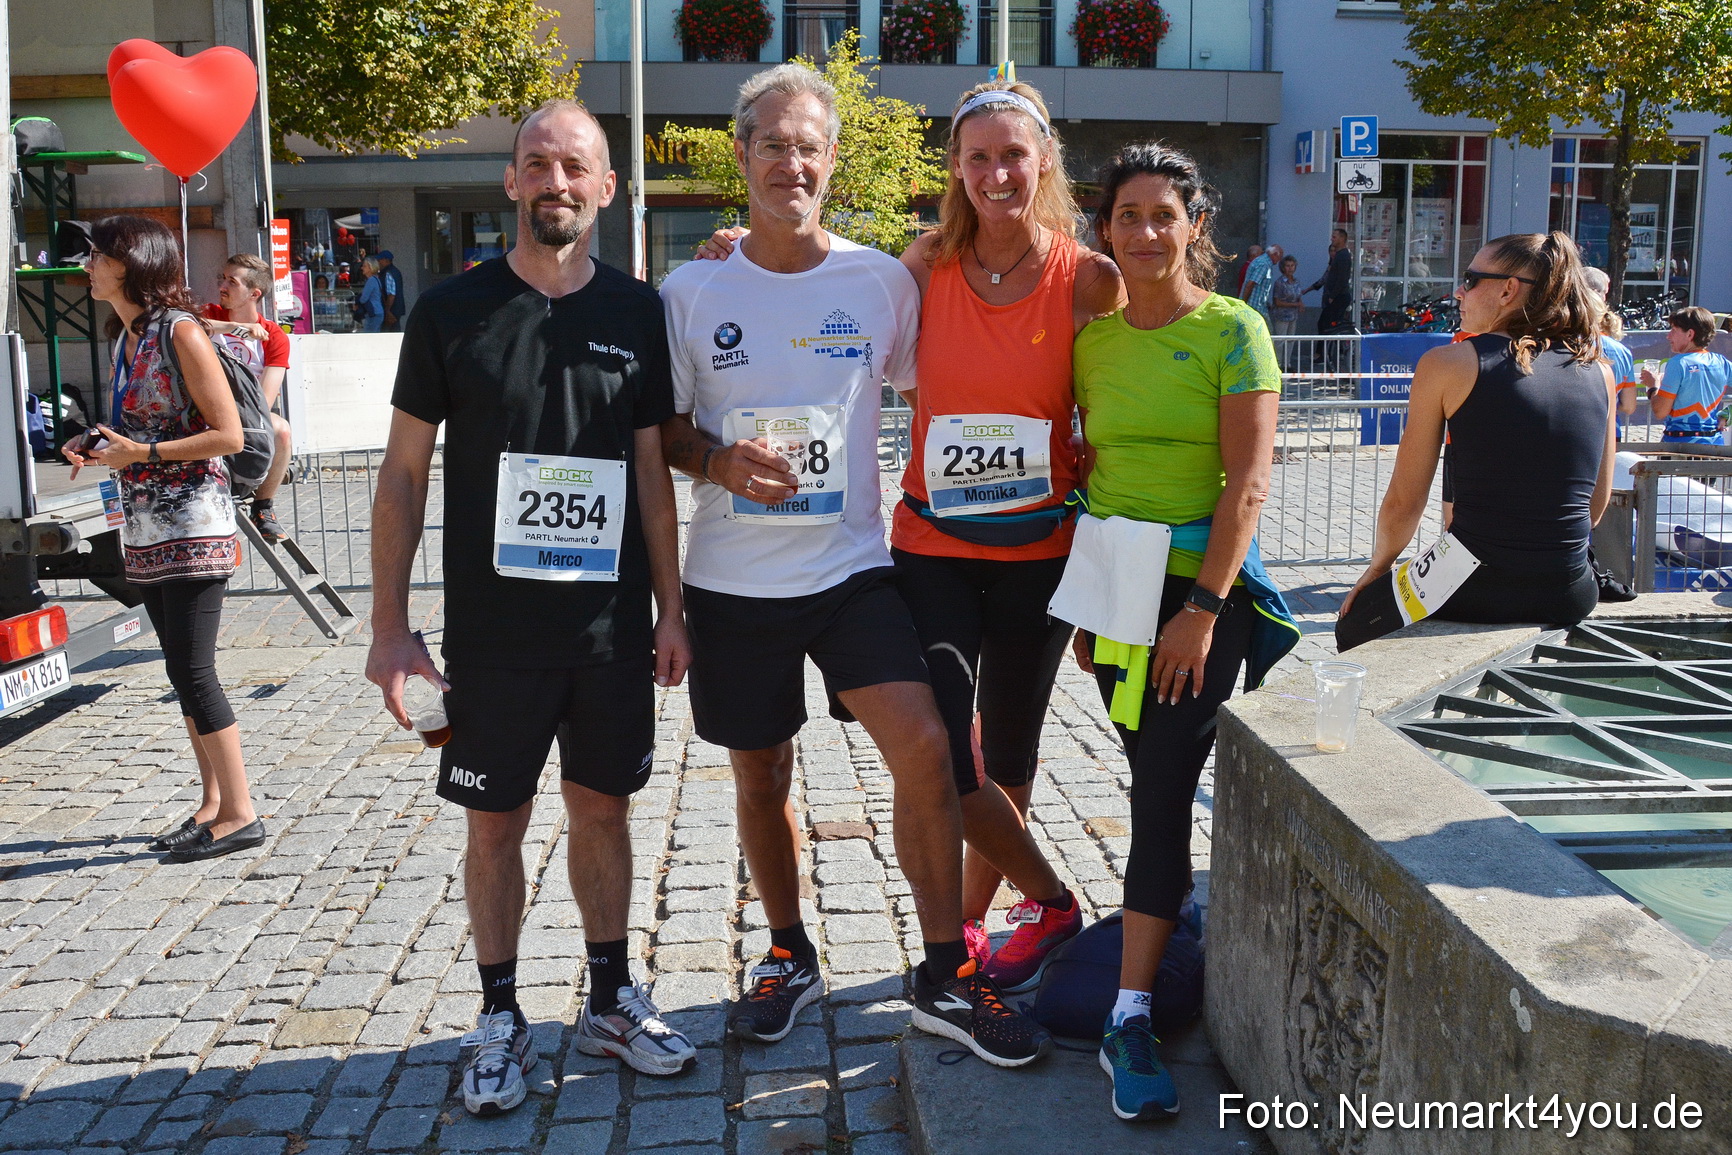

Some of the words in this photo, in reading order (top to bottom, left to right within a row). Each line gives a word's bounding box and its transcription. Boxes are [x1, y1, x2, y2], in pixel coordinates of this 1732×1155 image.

[1350, 121, 1370, 152] P
[790, 337, 811, 348] 14.
[588, 341, 608, 353] Thule
[610, 345, 630, 359] Group
[712, 350, 748, 364] PARTL
[713, 359, 749, 371] Neumarkt
[1380, 364, 1412, 373] STORE
[1380, 384, 1411, 394] ONLIN
[756, 418, 810, 431] BOCK
[963, 425, 1014, 437] BOCK
[942, 445, 1025, 476] 2341
[540, 467, 593, 483] BOCK
[980, 472, 1015, 482] Neumarkt
[964, 486, 1017, 502] Monika
[517, 490, 607, 530] 2354
[525, 533, 552, 541] PARTL
[554, 535, 588, 543] Neumarkt
[538, 550, 582, 567] Marco
[125, 619, 140, 632] ROTH
[3, 672, 24, 703] NM
[29, 667, 39, 693] X
[39, 658, 62, 688] 816
[449, 766, 487, 791] MDC
[588, 957, 608, 965] AKO
